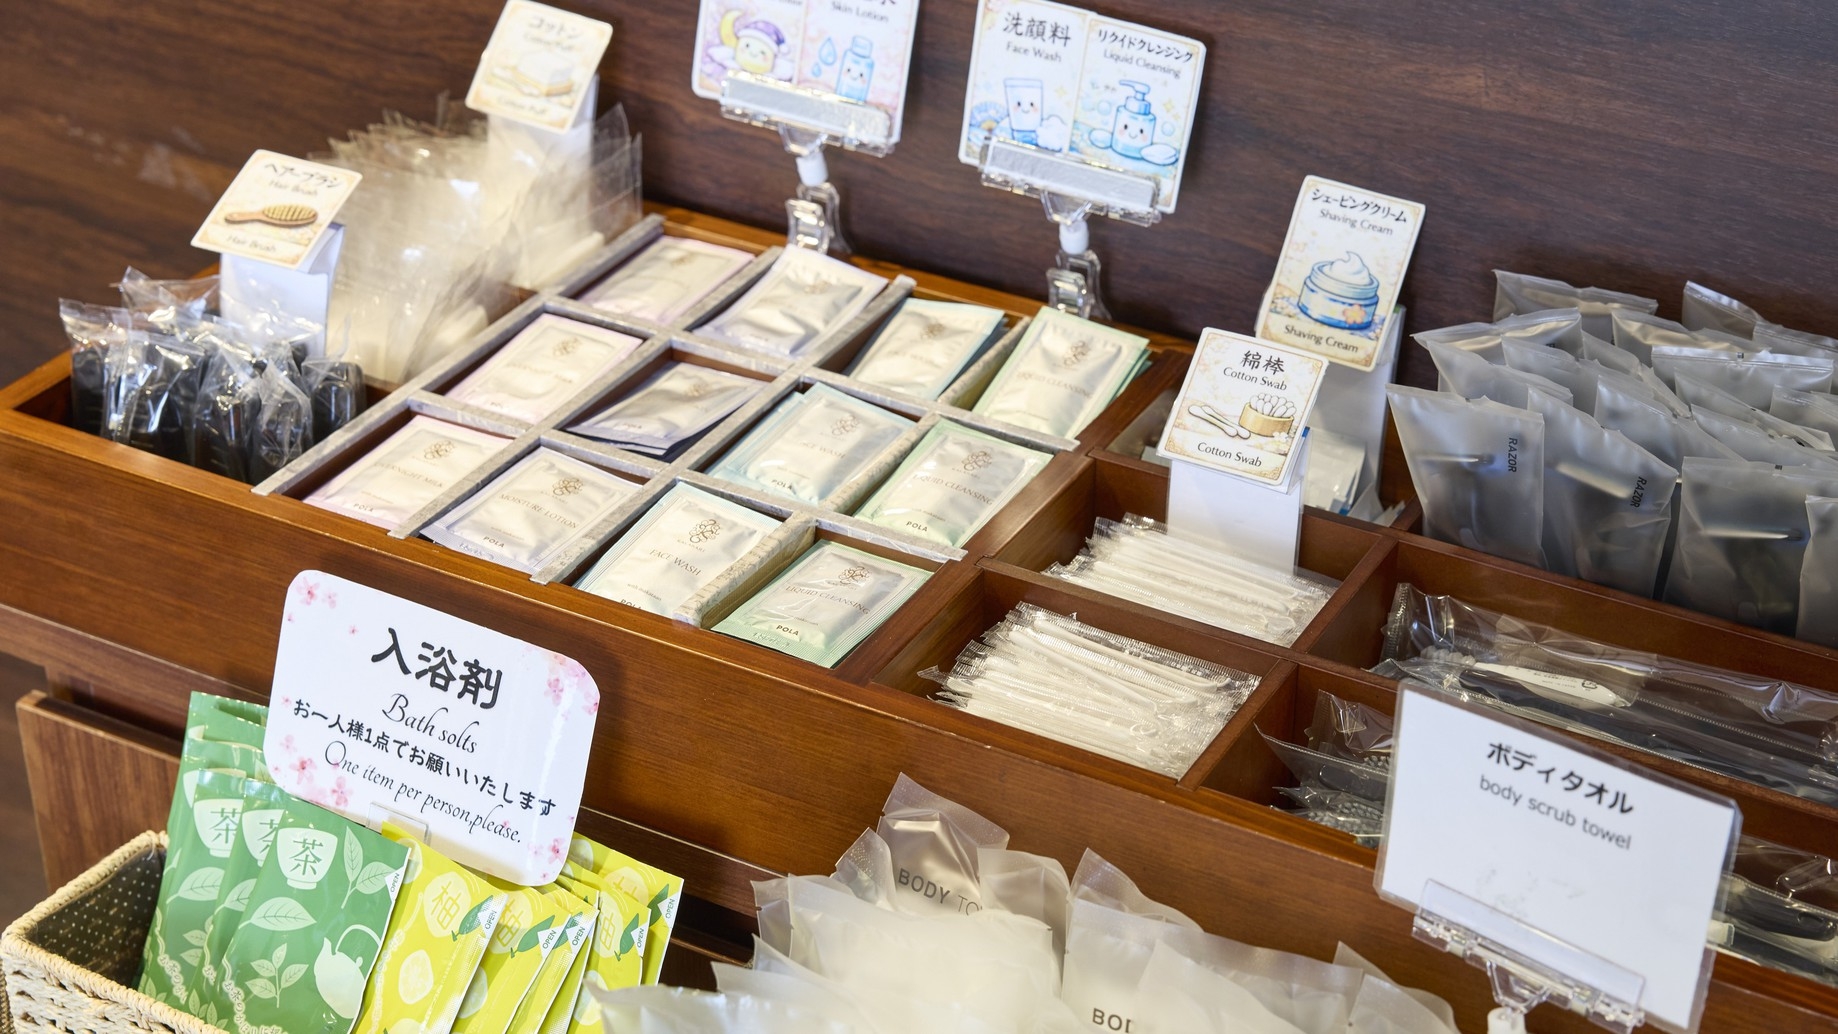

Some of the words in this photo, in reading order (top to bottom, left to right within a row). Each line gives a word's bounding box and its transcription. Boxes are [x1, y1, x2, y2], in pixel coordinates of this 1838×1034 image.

[856, 7, 889, 22] Lotion
[1003, 12, 1071, 47] 洗顔料
[1006, 41, 1030, 56] Face
[1033, 47, 1062, 63] Wash
[1104, 49, 1134, 65] Liquid
[1136, 57, 1181, 79] Cleansing
[1311, 188, 1407, 223] シェービングクリーム
[1319, 208, 1359, 229] Shaving
[1360, 220, 1394, 236] Cream
[1284, 324, 1323, 345] Shaving
[1325, 336, 1360, 353] Cream
[1240, 350, 1286, 376] 綿棒
[1223, 366, 1258, 384] Cotton
[1261, 376, 1288, 392] Swab
[1196, 441, 1233, 460] Cotton
[1234, 451, 1262, 468] Swab
[1507, 437, 1518, 473] RAZOR
[944, 481, 993, 506] CLEANSING
[1630, 476, 1648, 508] RAZOR
[545, 510, 578, 529] LOTION
[906, 521, 928, 532] POLA
[483, 536, 505, 548] POLA
[649, 548, 673, 560] FACE
[673, 557, 702, 576] WASH
[785, 585, 818, 596] LIQUID
[819, 592, 871, 615] CLEANSING
[776, 624, 799, 636] POLA
[370, 627, 503, 710] 入浴剤
[382, 693, 448, 738] Bath
[293, 698, 557, 817] お一人様1点でお願いいたします
[324, 740, 360, 776] One
[362, 764, 395, 790] item
[395, 782, 422, 803] per
[1487, 741, 1635, 816] ボディタオル
[1479, 774, 1523, 807] body
[1527, 792, 1577, 829] scrub
[1582, 816, 1632, 851] towel
[289, 838, 325, 876] 茶
[390, 872, 400, 893] OPEN
[898, 867, 950, 904] BODY
[958, 894, 983, 916] TO
[431, 881, 463, 930] 柚
[665, 898, 675, 919] OPEN
[484, 910, 497, 930] OPEN
[542, 930, 557, 949] OPEN
[572, 926, 586, 946] OPEN
[637, 928, 645, 948] OPEN
